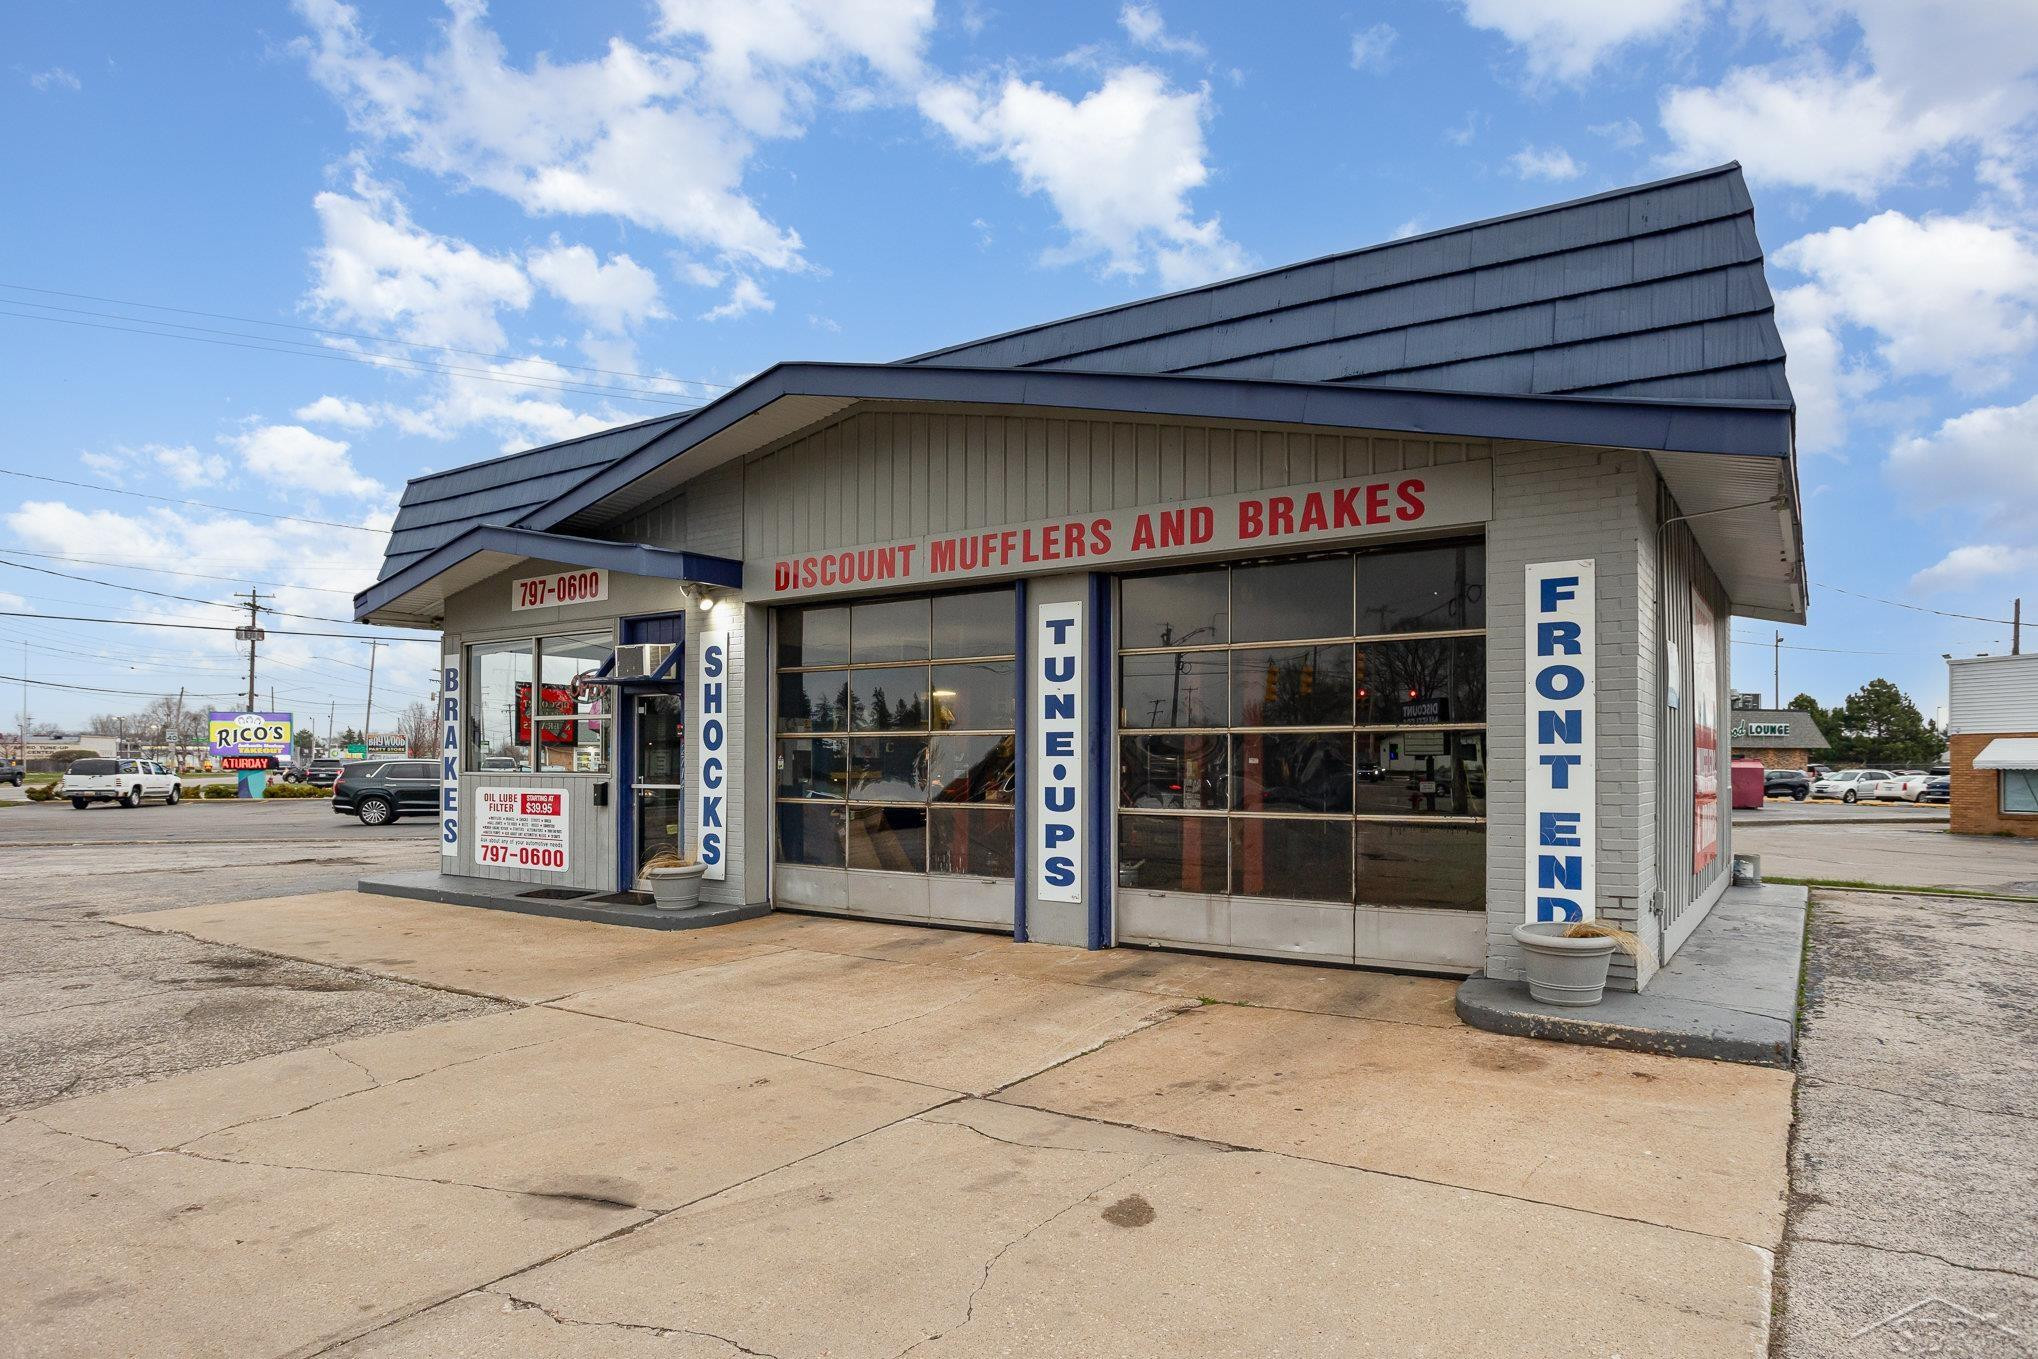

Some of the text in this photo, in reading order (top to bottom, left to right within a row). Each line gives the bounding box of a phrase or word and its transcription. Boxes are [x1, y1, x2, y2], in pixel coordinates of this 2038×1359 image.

[774, 479, 1425, 591] DISCOUNT MUFFLERS AND BRAKES
[520, 570, 599, 606] 797-0600
[217, 726, 283, 748] RICO'S
[1749, 725, 1790, 735] LOUNGE
[444, 667, 459, 843] BRAKES
[702, 646, 723, 865] SHOCKS
[1535, 576, 1585, 923] FRONT END
[484, 793, 518, 803] OIL LUBE
[489, 803, 514, 812] FILTER
[525, 802, 553, 814] $39.95
[526, 794, 548, 802] STARTING
[480, 844, 564, 868] 797-0600
